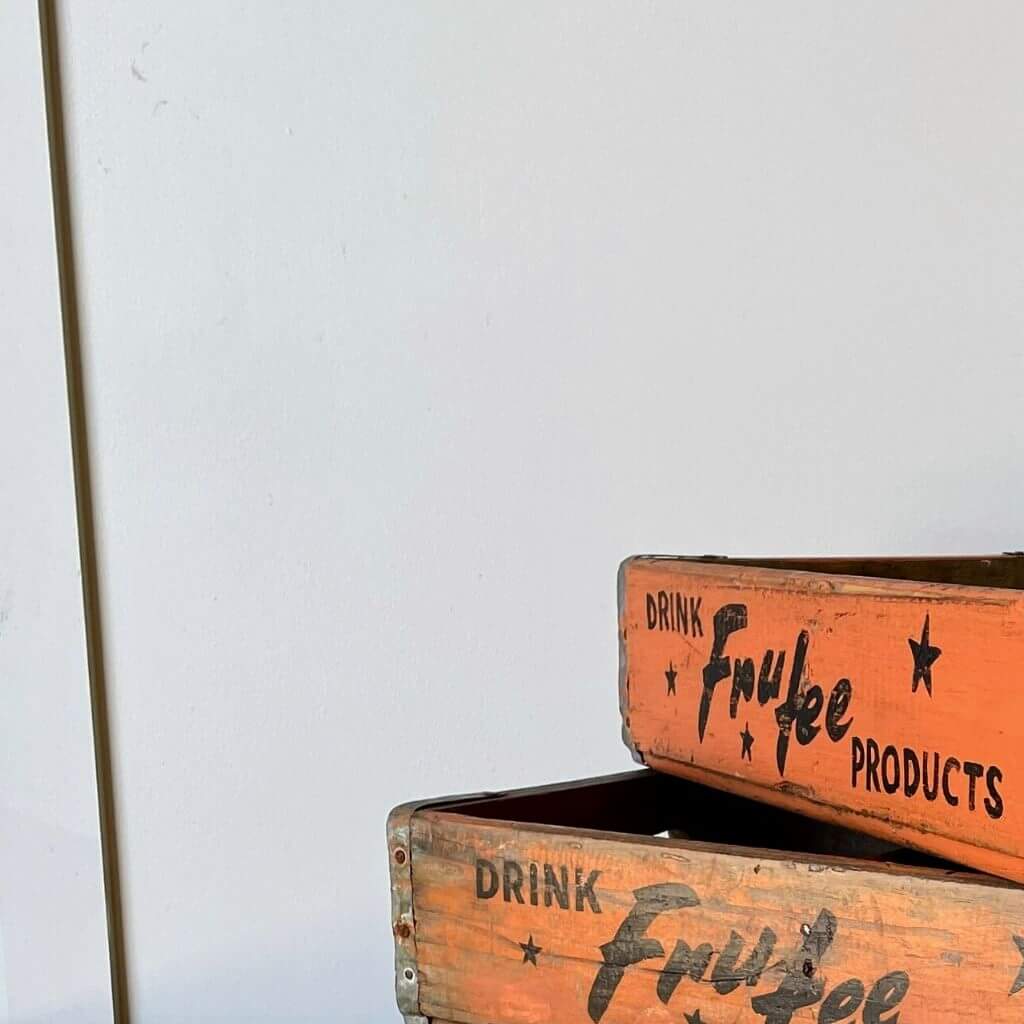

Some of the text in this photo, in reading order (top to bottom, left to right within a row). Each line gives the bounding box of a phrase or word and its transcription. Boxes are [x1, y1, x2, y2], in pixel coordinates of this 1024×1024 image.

[646, 591, 704, 637] DRINK
[851, 737, 1004, 819] PRODUCTS
[474, 858, 602, 914] DRINK
